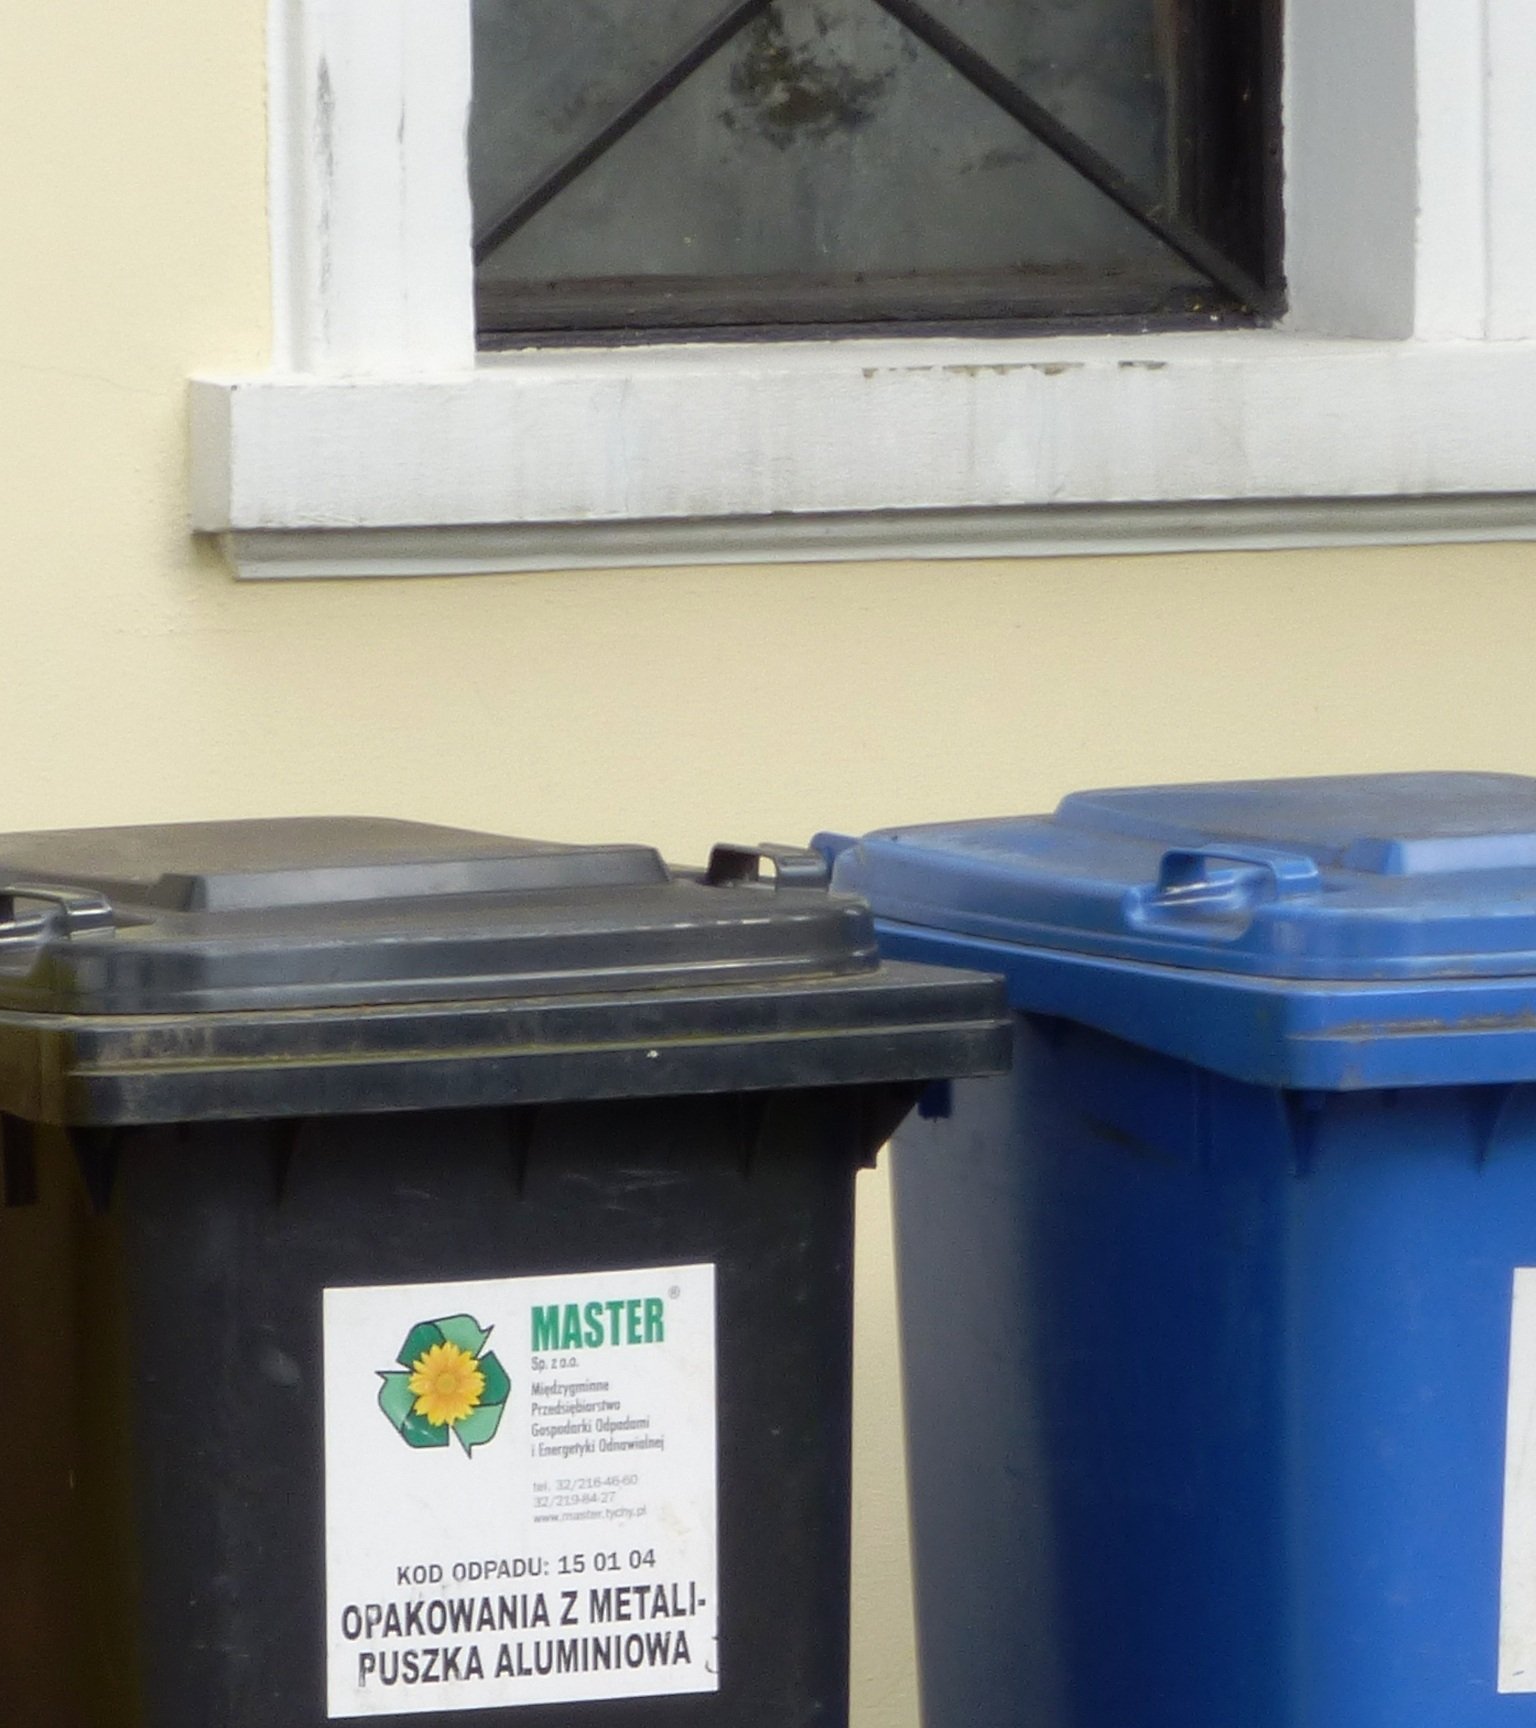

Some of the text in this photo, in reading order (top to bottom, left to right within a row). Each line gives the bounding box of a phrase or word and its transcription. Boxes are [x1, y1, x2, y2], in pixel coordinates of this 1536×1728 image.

[531, 1298, 664, 1352] MASTER
[531, 1357, 579, 1372] Sp. z o.o.
[531, 1379, 609, 1398] Międzygminne
[531, 1398, 621, 1416] Przedsiębiorstwo
[532, 1416, 650, 1438] Gospodarki Odpadami
[532, 1435, 664, 1458] i Energetyki Odnawialnej
[397, 1549, 656, 1585] KOD ODPADU: 15 01 04
[342, 1593, 550, 1640] OPAKOWANIA
[560, 1591, 578, 1625] Z
[359, 1630, 691, 1686] PUSZKA ALUMINIOWA
